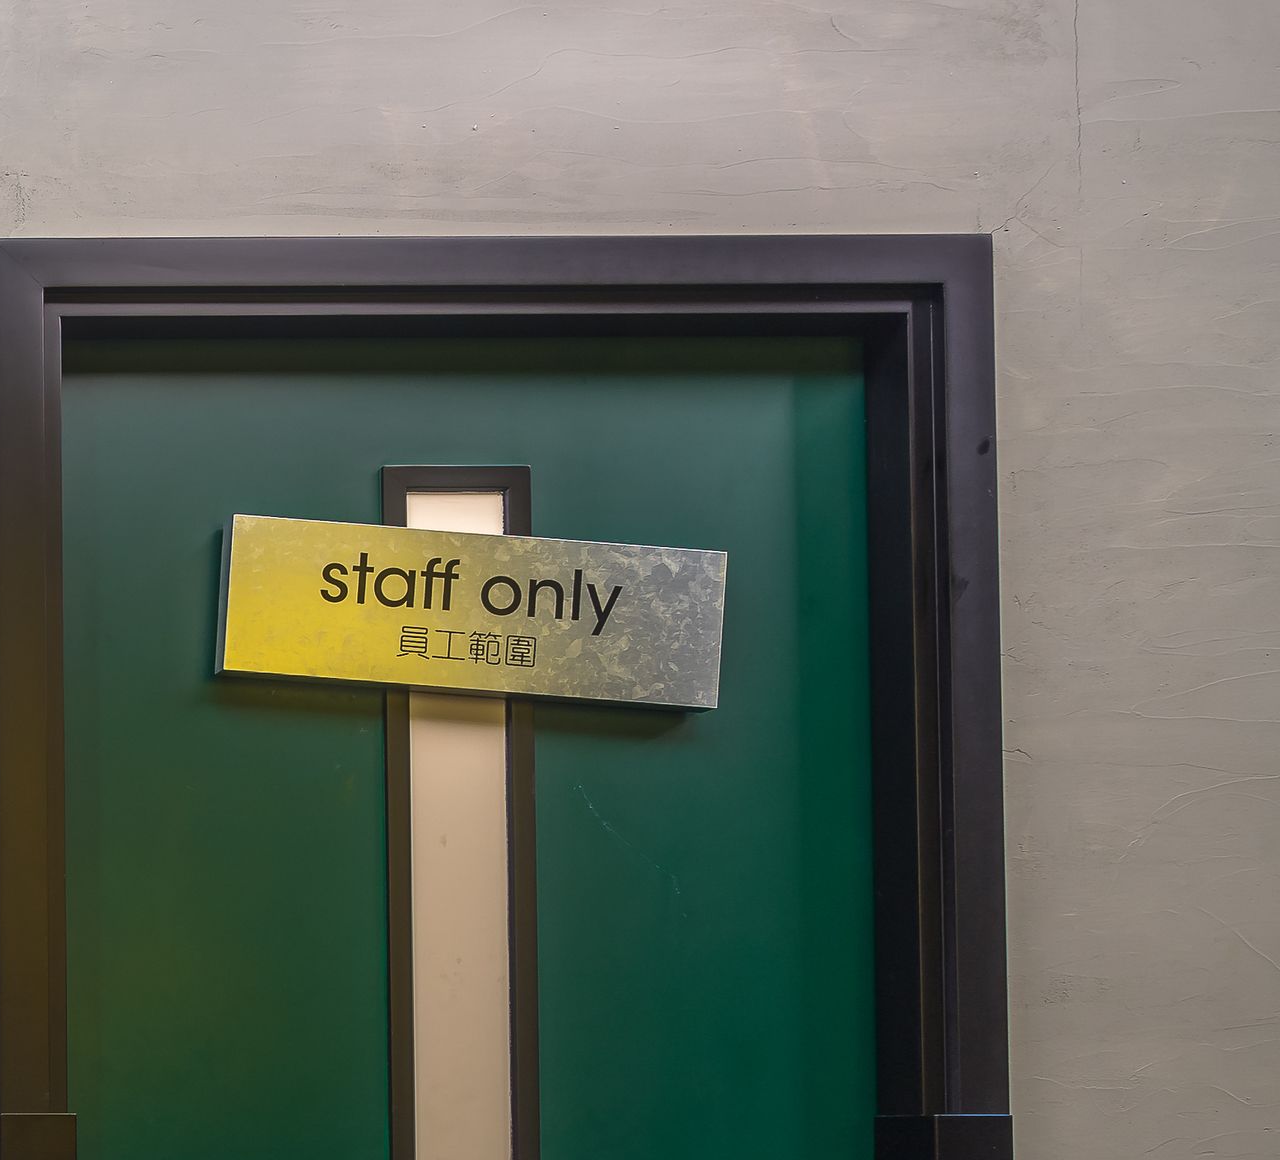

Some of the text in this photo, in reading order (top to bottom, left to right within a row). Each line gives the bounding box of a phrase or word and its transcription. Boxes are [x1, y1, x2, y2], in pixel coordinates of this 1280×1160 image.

[320, 552, 623, 636] staff only
[396, 626, 537, 668] 員工範圍
